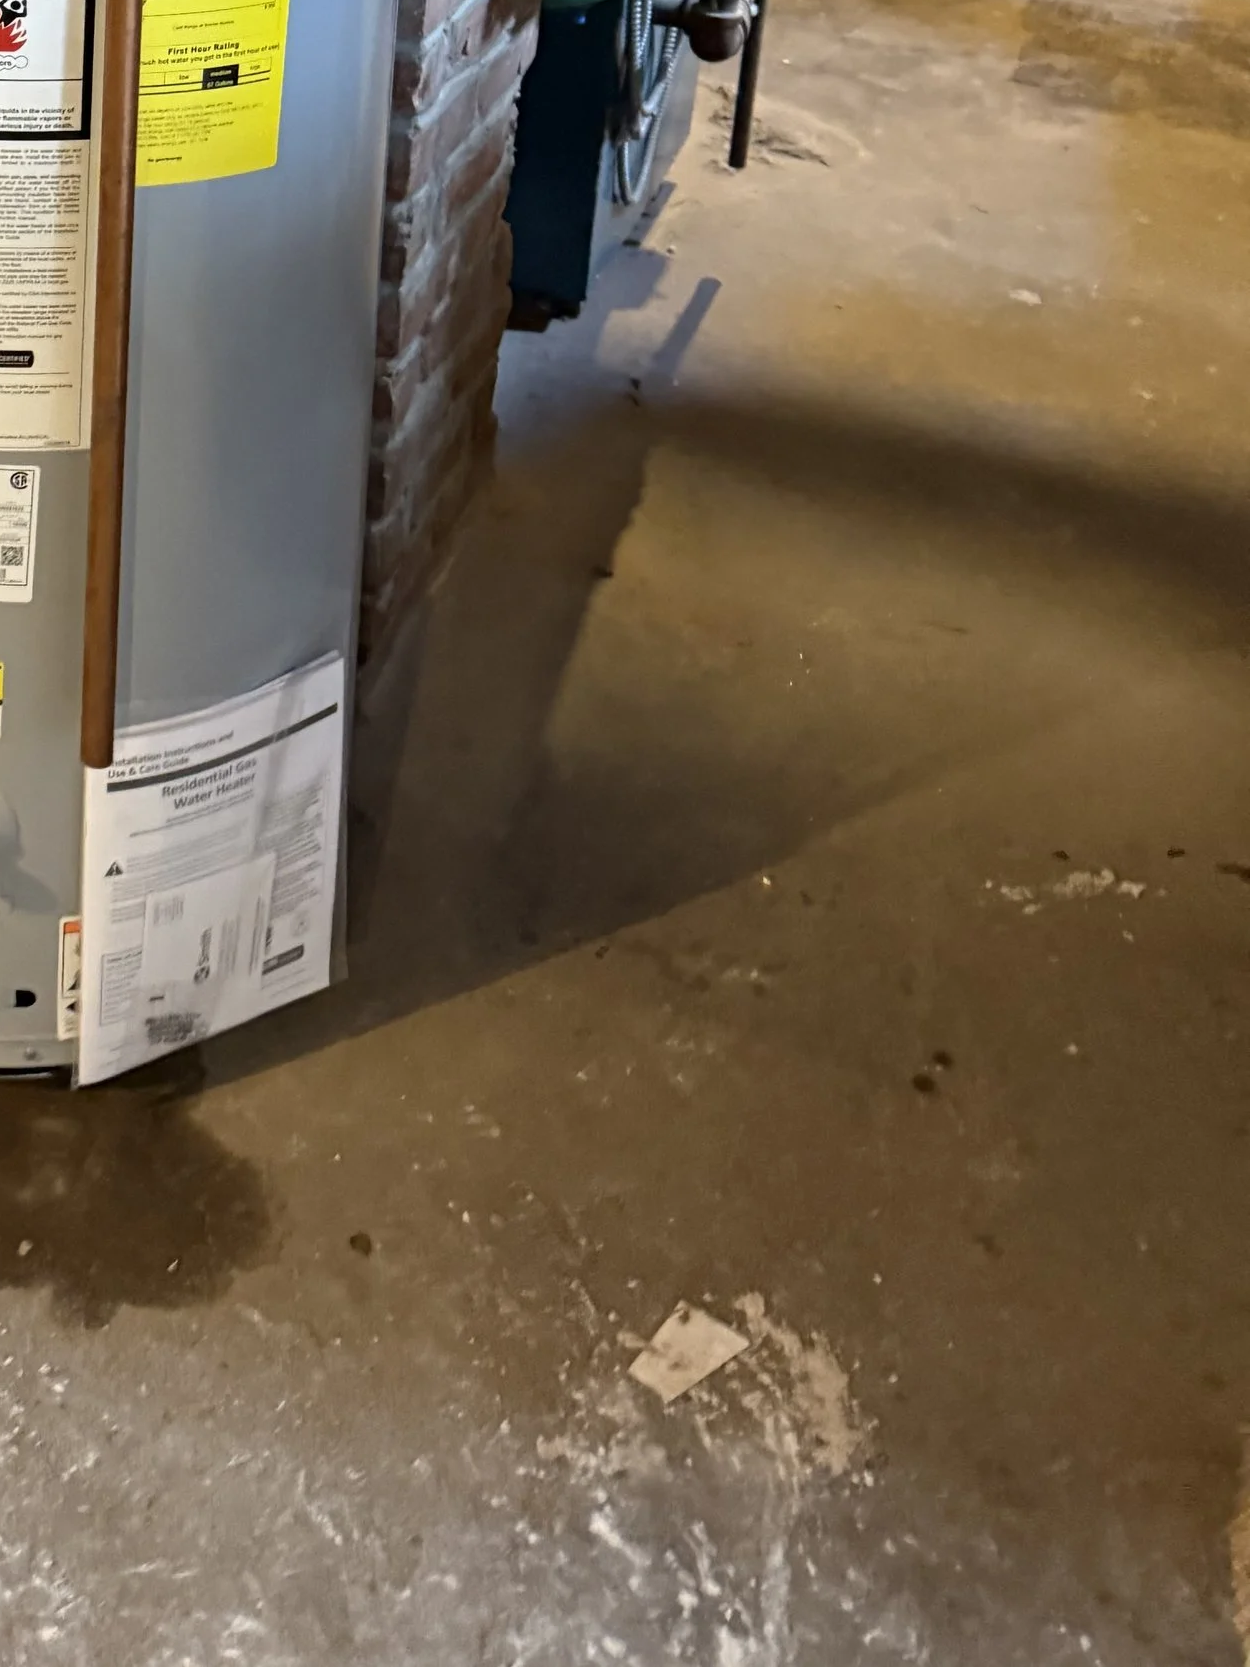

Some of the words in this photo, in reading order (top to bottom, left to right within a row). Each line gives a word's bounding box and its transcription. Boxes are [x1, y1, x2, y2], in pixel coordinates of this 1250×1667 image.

[158, 56, 169, 65] hot
[171, 56, 189, 65] water
[190, 56, 202, 64] you
[168, 46, 188, 56] First
[191, 44, 211, 53] Hour
[214, 42, 240, 51] Rating
[111, 750, 162, 767] nstallation
[164, 738, 216, 759] Instructions
[218, 731, 234, 744] and
[108, 769, 126, 779] Use
[128, 766, 137, 775] &
[139, 763, 160, 775] Care
[163, 756, 189, 770] Guide
[162, 764, 233, 797] Residential
[235, 757, 258, 774] Gas
[174, 791, 211, 810] Water
[216, 771, 256, 797] Heater
